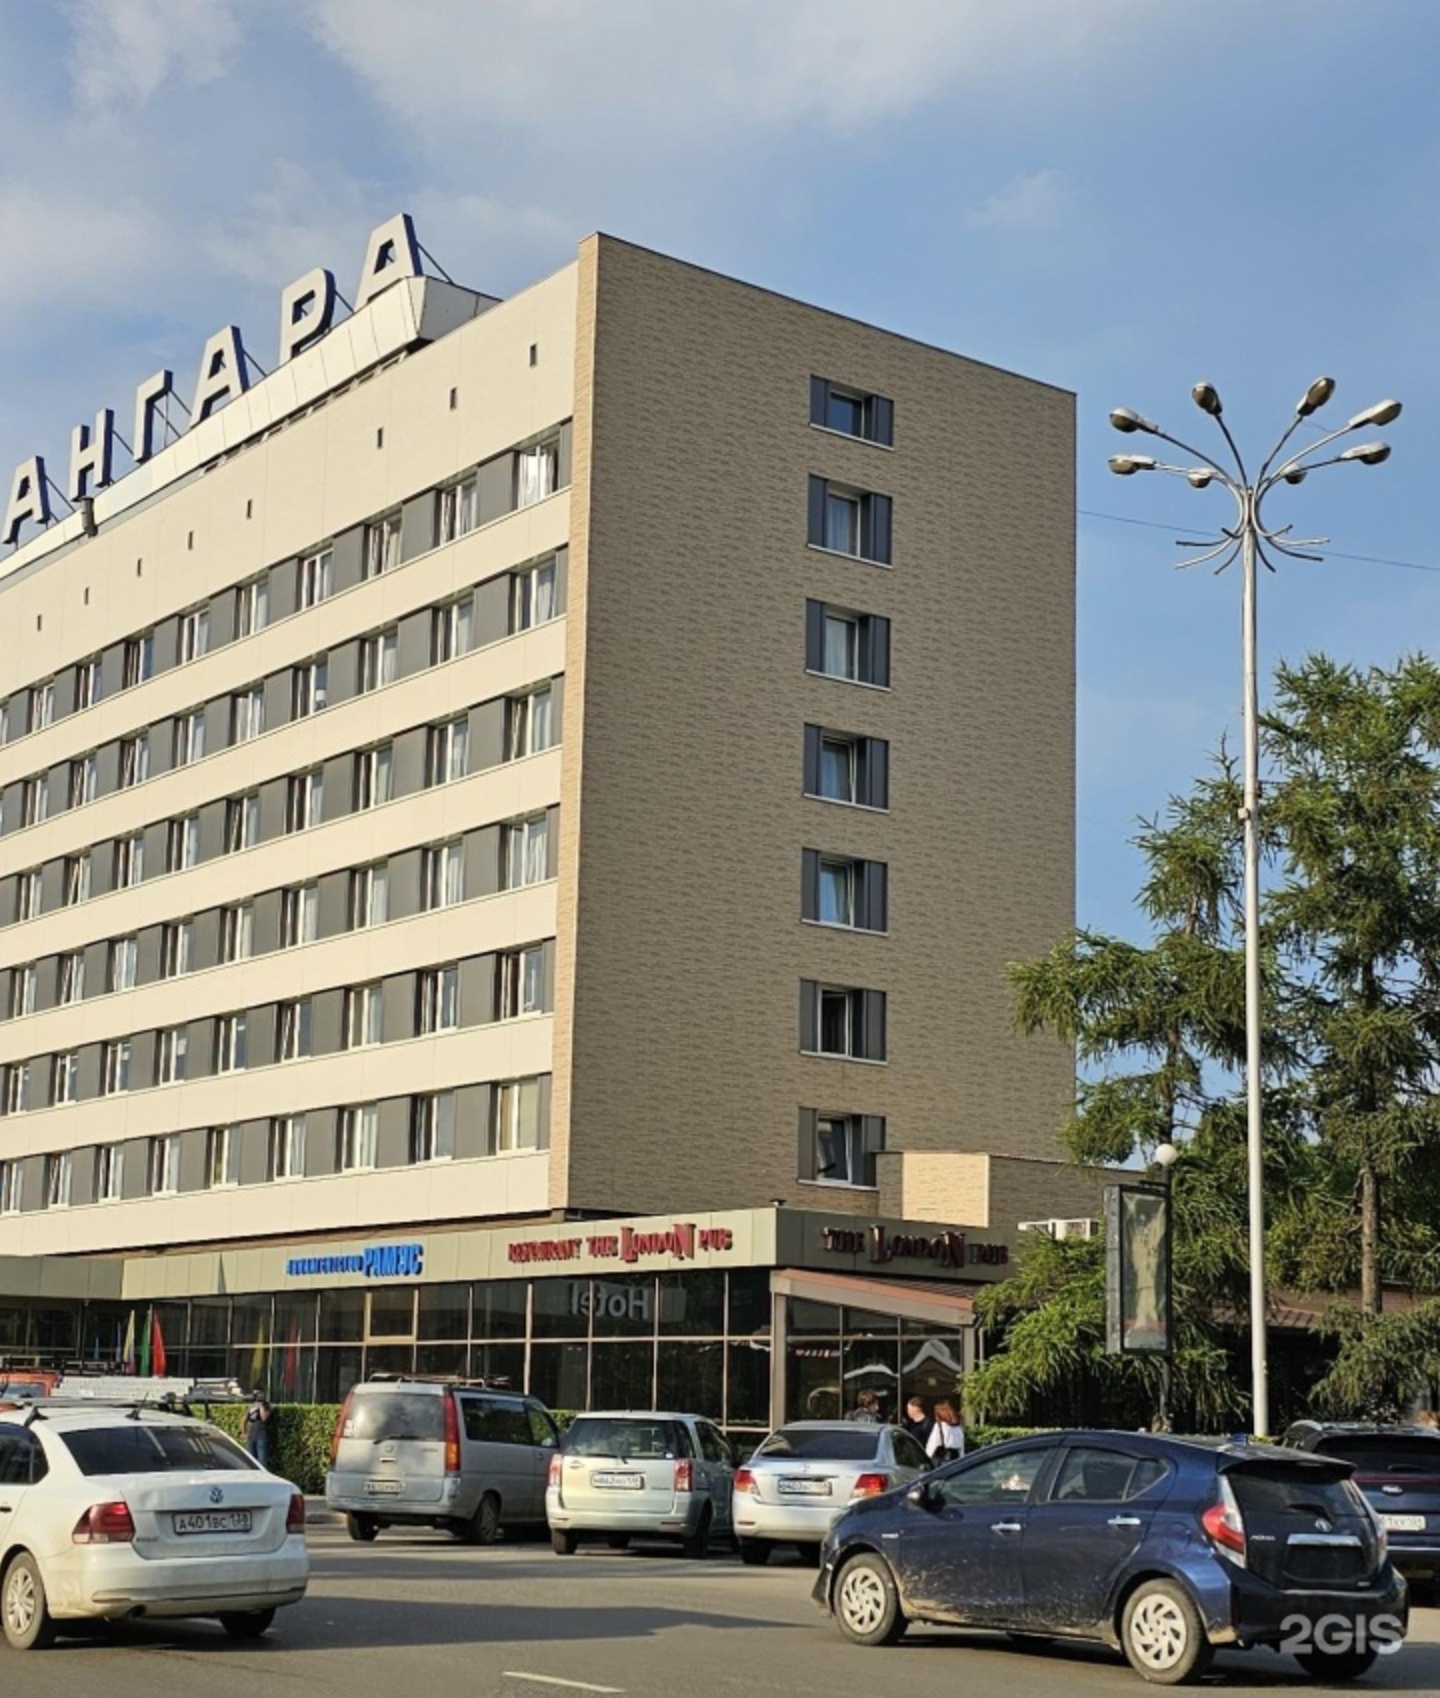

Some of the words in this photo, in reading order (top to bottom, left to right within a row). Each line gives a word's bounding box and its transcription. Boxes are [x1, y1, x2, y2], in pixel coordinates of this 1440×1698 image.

[0, 212, 423, 545] АНГАРА
[586, 1235, 618, 1258] THE
[698, 1228, 733, 1251] PUB
